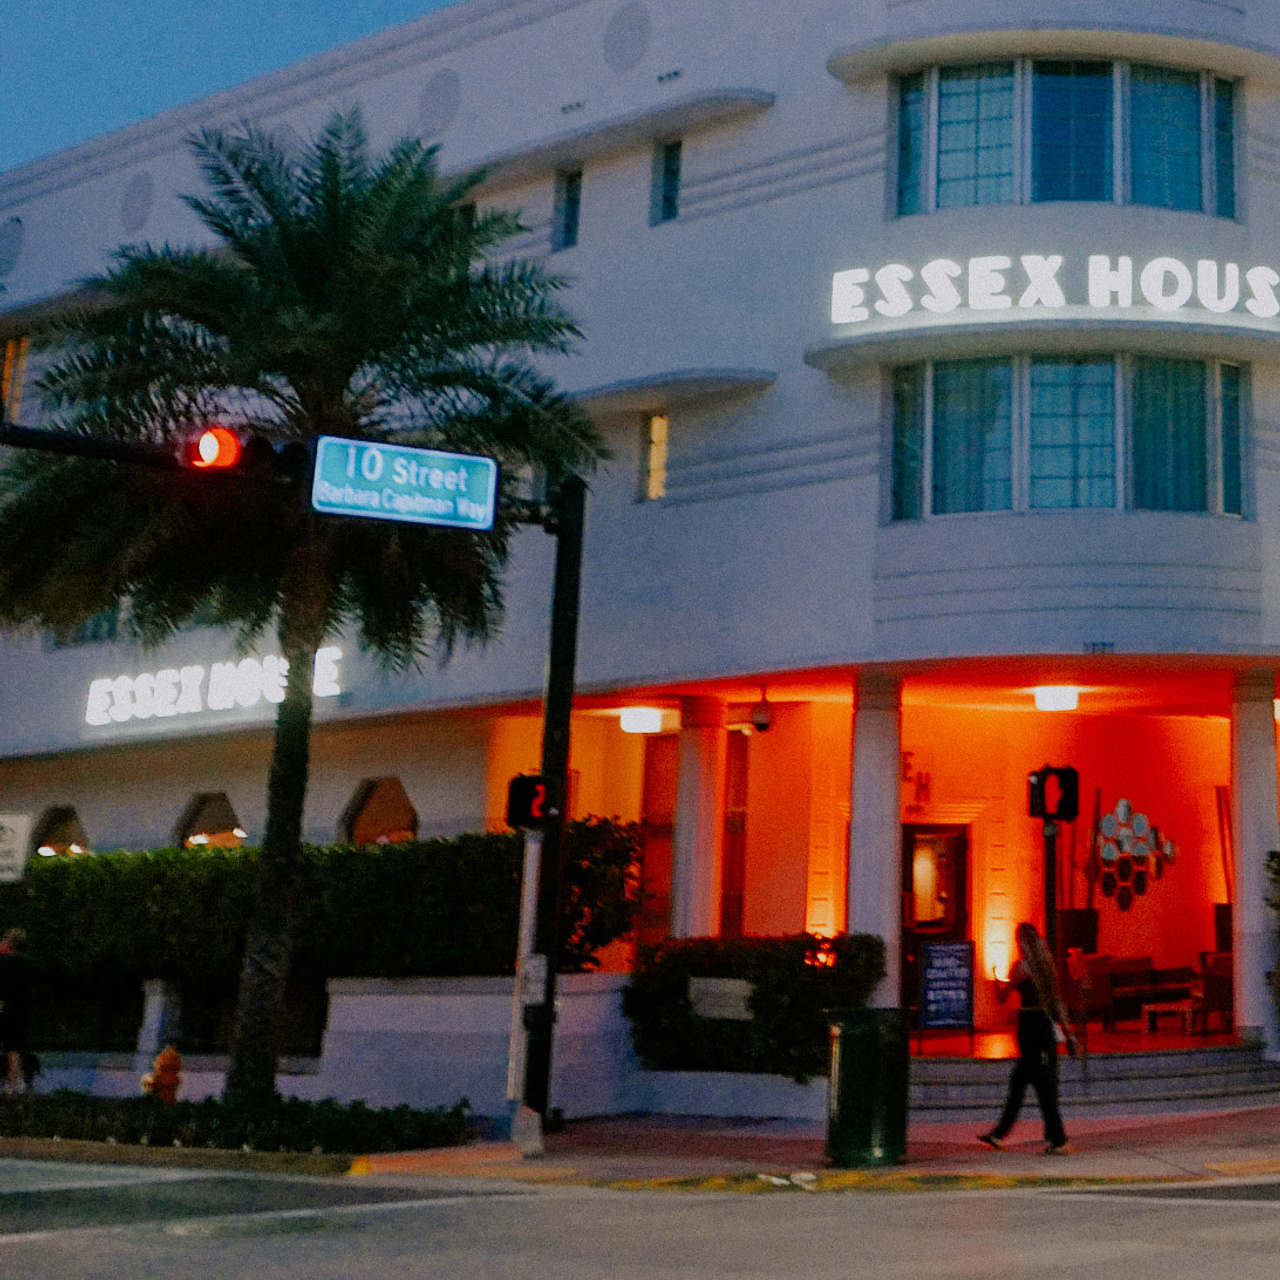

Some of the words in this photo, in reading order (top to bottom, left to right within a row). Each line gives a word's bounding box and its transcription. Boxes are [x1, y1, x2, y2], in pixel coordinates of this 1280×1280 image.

[831, 255, 1066, 324] ESSEX
[346, 446, 384, 482] 10
[391, 456, 468, 493] Street
[86, 664, 206, 726] ESSEX
[207, 646, 343, 710] HOUE
